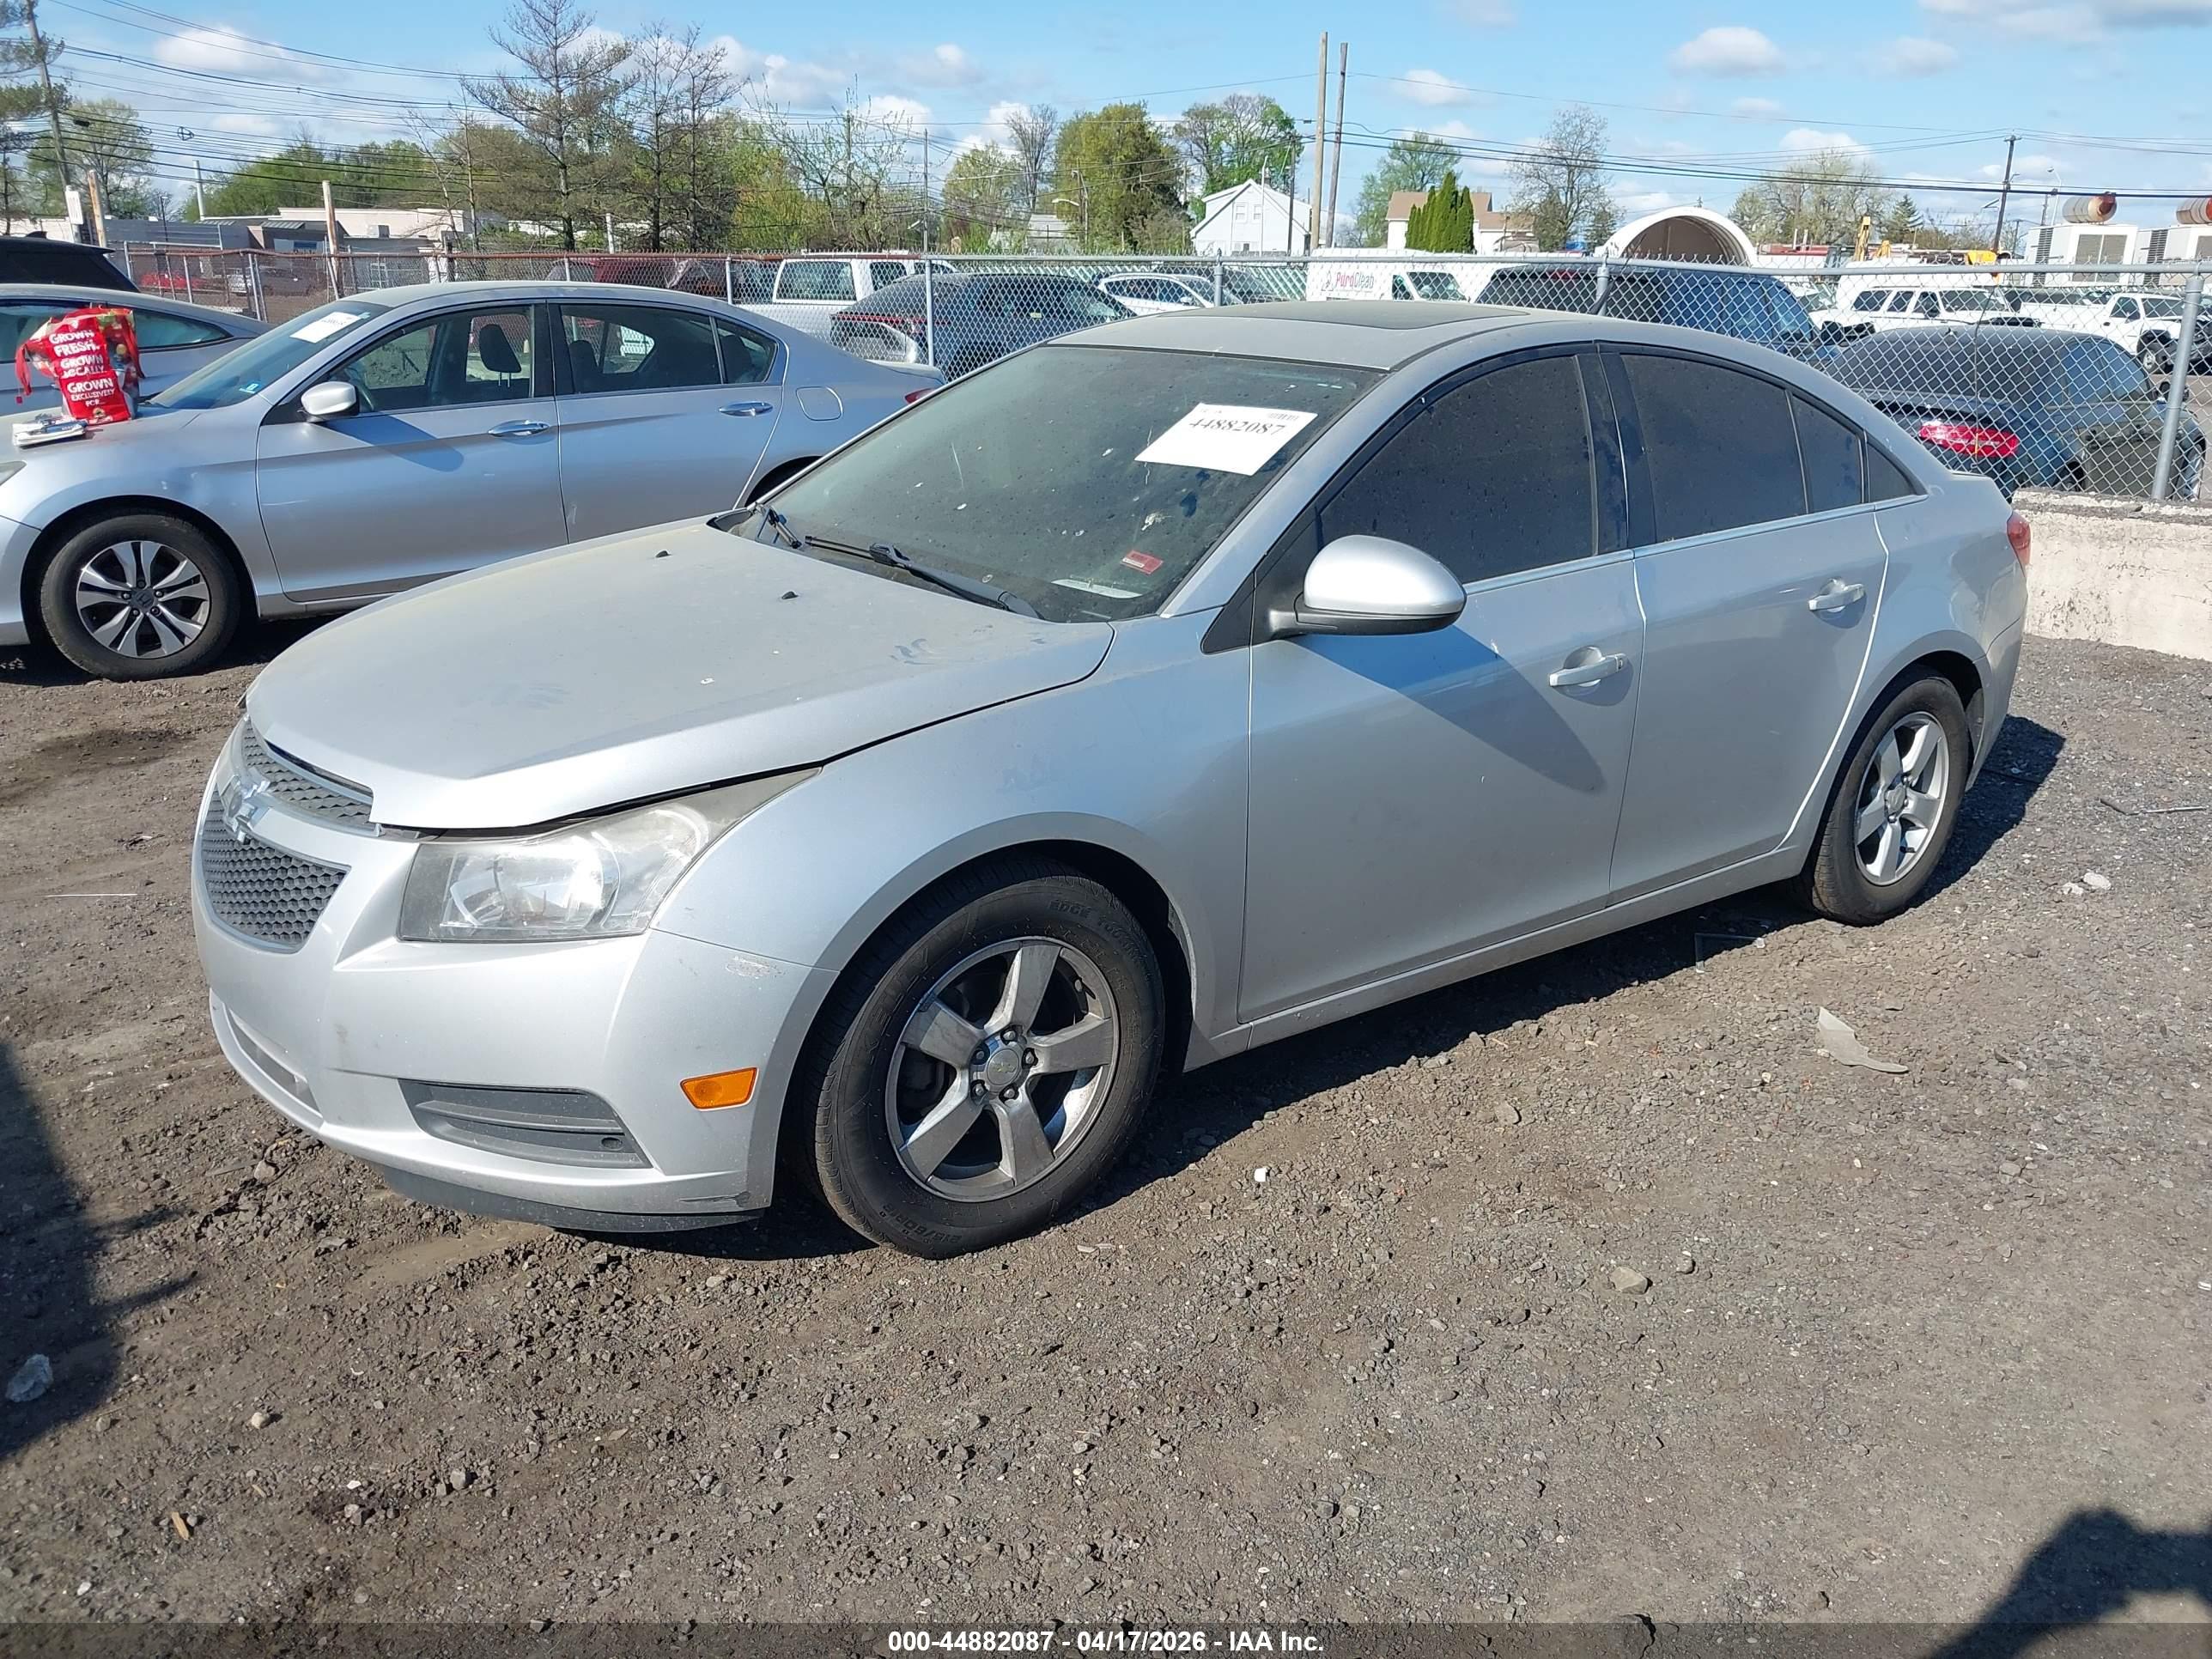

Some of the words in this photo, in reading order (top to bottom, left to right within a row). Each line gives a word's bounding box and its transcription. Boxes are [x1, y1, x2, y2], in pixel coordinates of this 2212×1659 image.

[49, 330, 94, 343] GROWN
[60, 354, 104, 368] GROWN
[67, 378, 113, 393] GROWN
[70, 388, 115, 401] EXCLUSIVELY
[1188, 418, 1285, 435] 44882087
